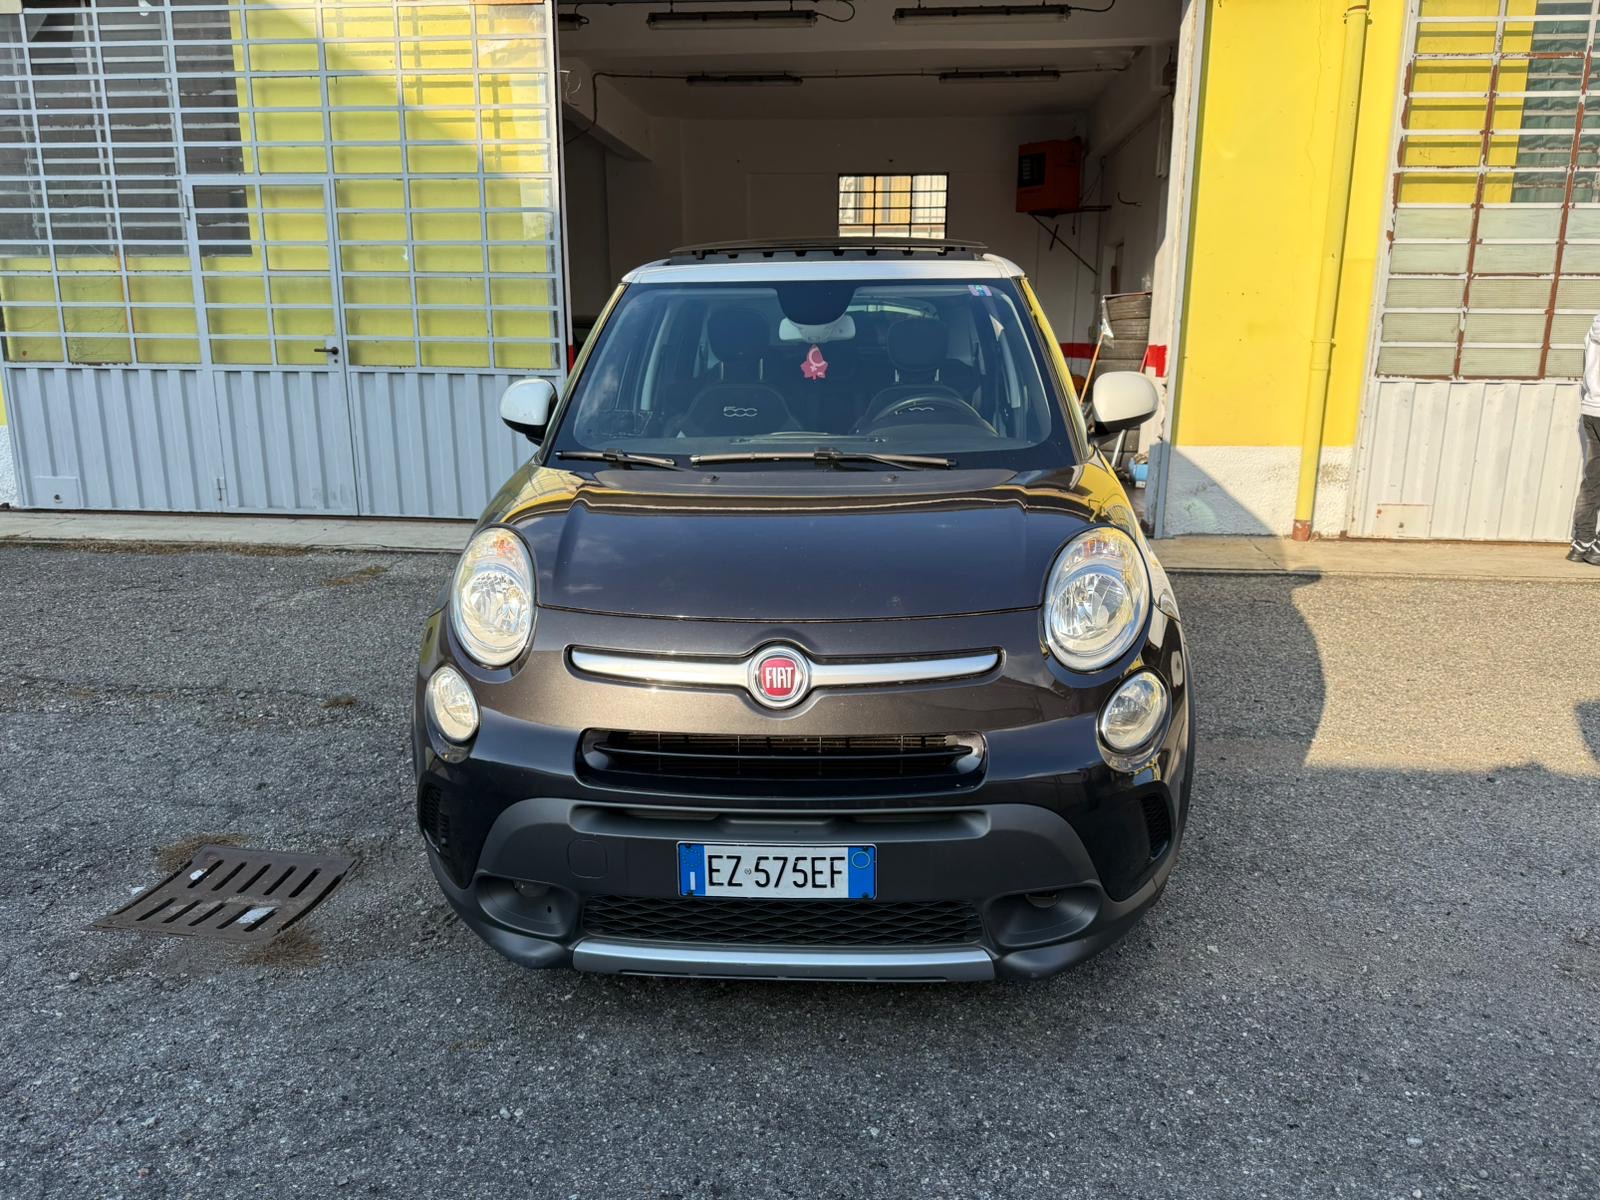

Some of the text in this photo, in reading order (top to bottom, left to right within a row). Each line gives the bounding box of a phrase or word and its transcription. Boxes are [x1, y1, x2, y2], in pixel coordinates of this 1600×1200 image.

[765, 666, 794, 689] FIAT
[707, 854, 846, 888] EZ 575EF
